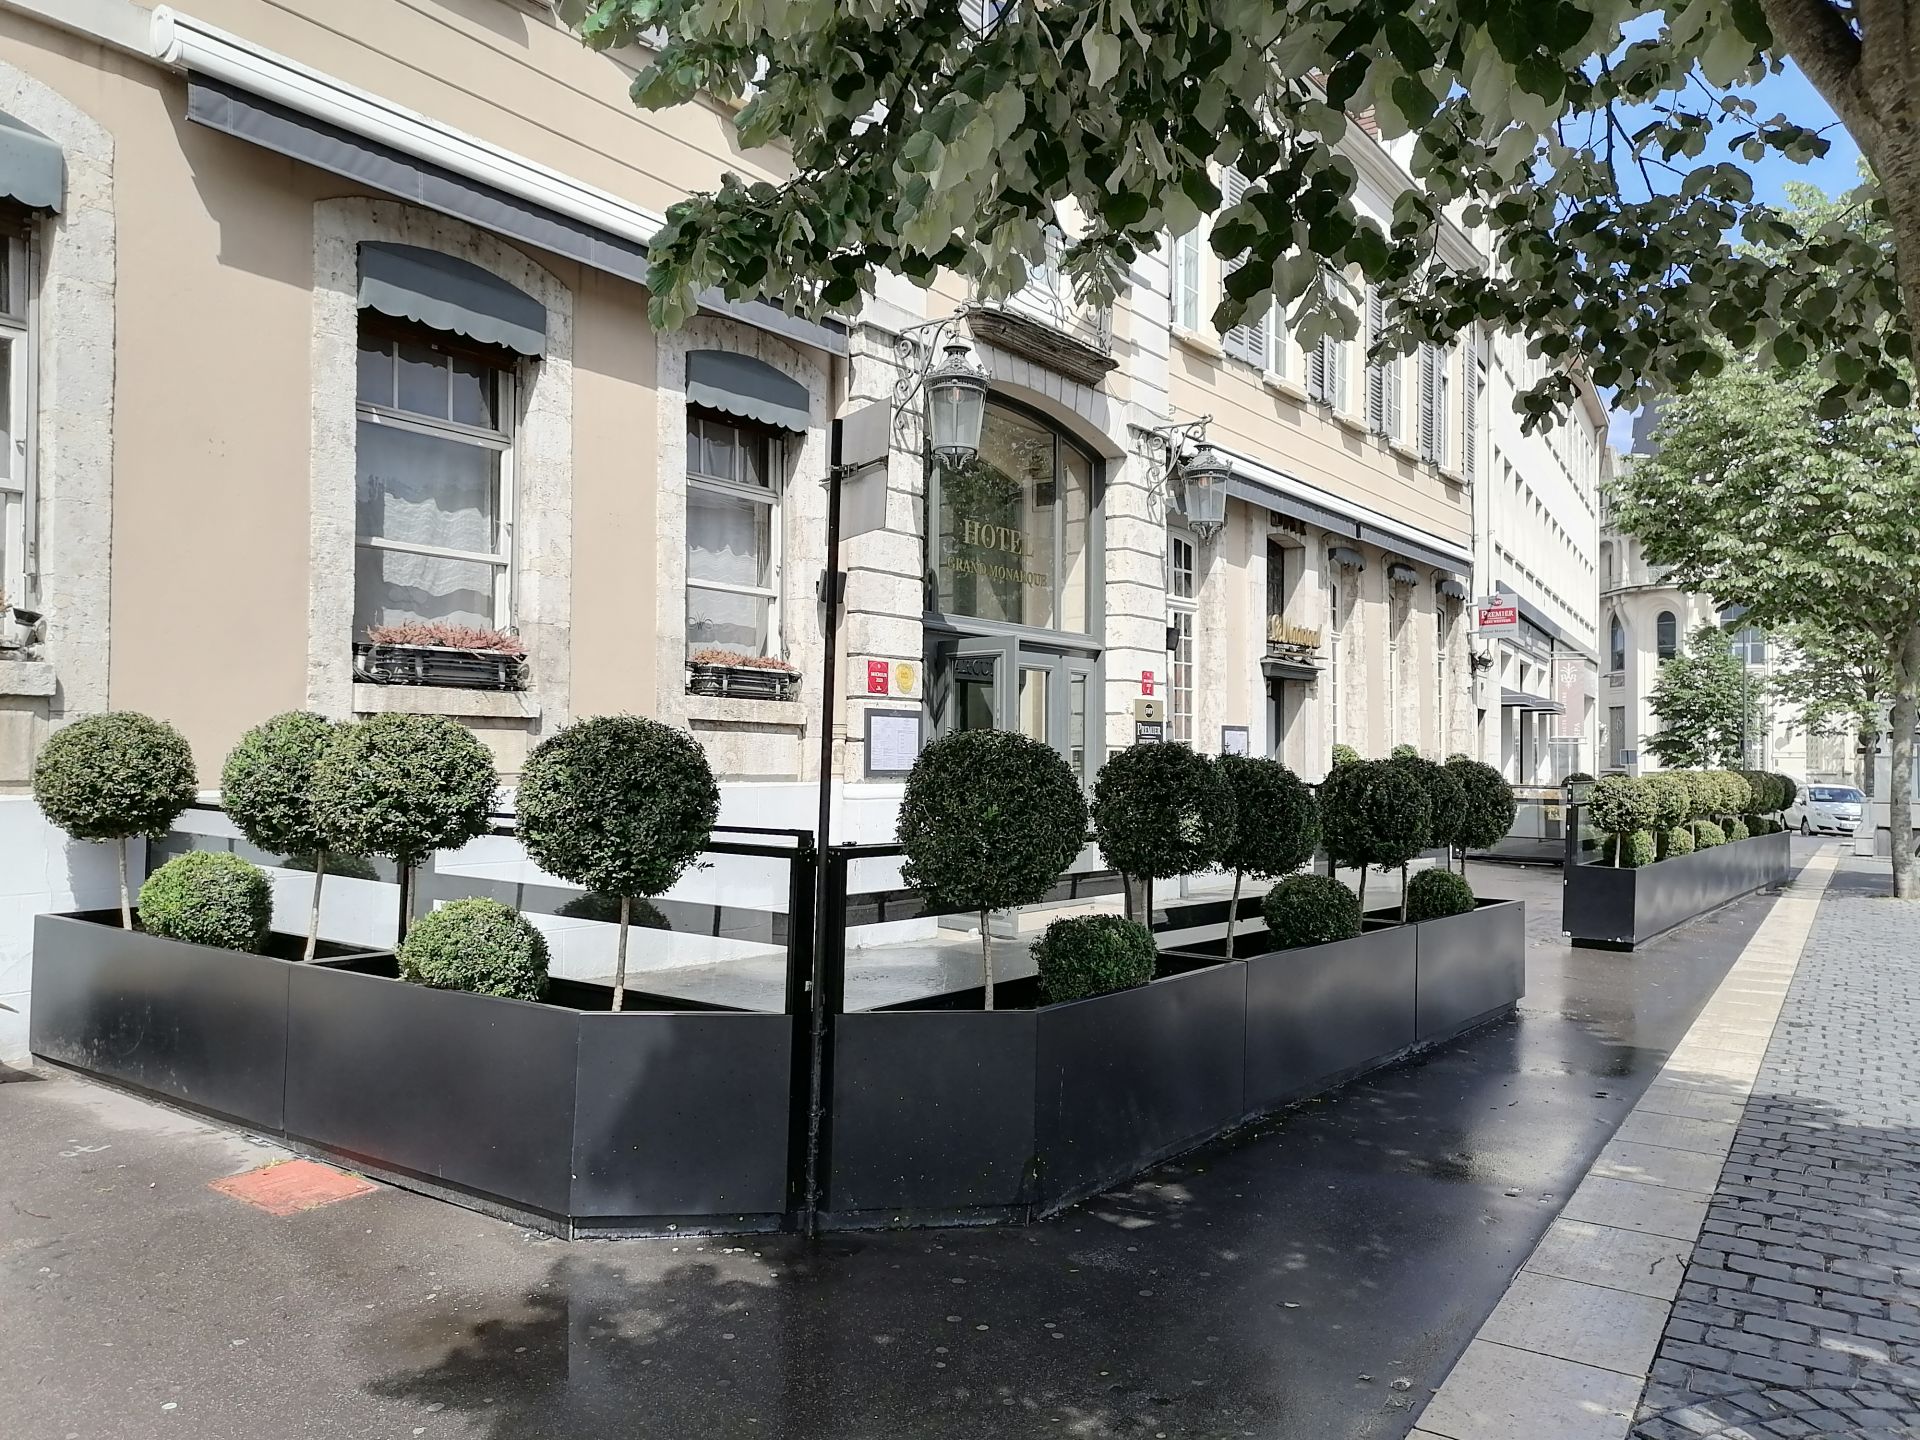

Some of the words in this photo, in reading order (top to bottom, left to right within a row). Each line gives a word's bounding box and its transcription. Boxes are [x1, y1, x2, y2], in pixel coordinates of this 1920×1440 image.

[947, 556, 987, 577] GRAND
[989, 564, 1048, 588] MONARQUE
[1481, 610, 1514, 619] PREMIER
[1137, 722, 1162, 736] PREMIER
